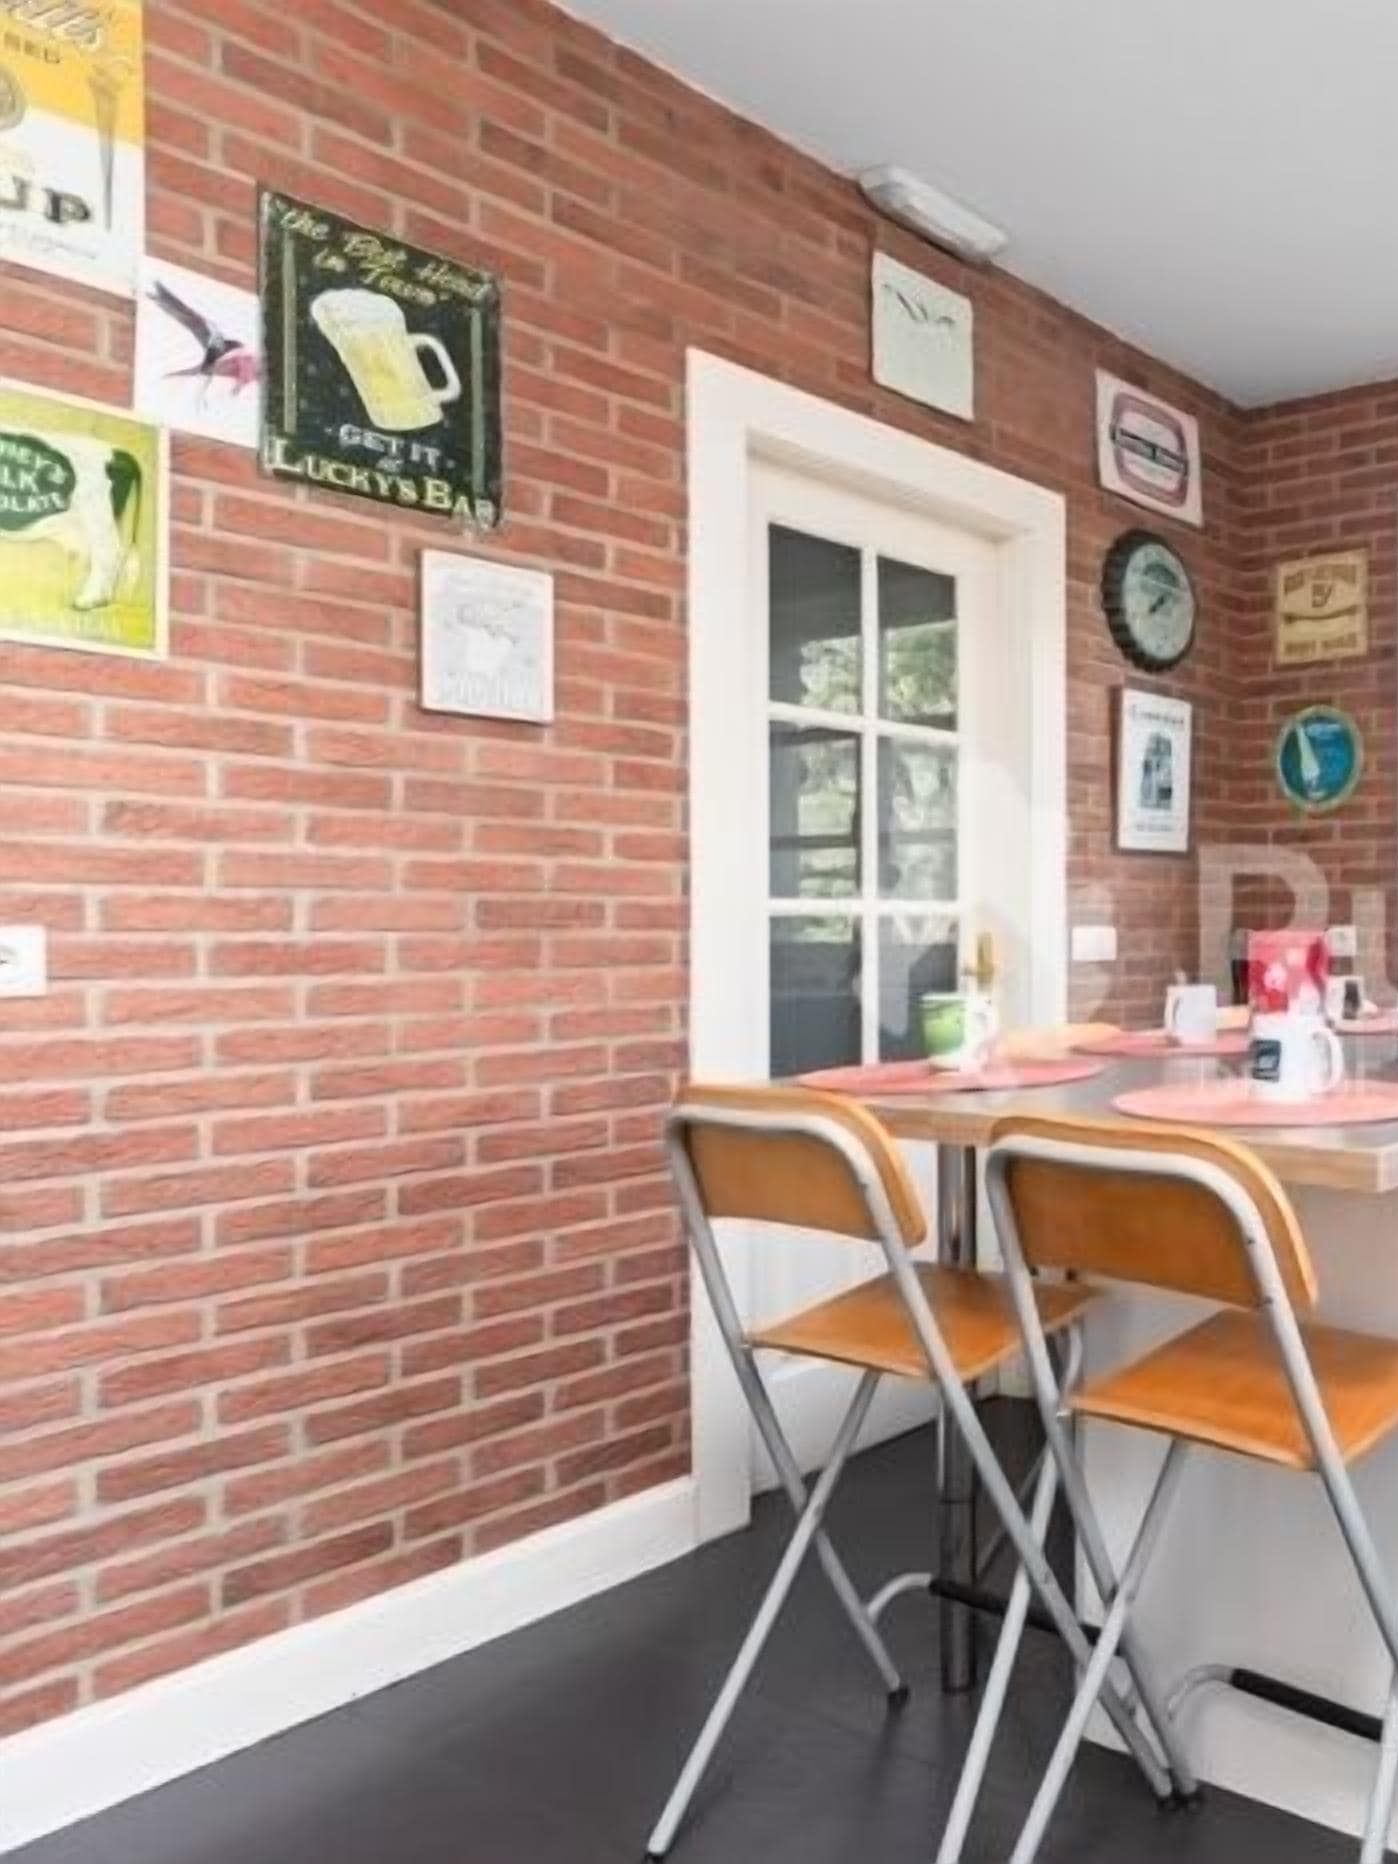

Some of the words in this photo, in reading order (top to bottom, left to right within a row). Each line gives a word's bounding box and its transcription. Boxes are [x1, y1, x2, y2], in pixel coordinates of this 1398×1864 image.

[338, 422, 404, 455] GET
[410, 442, 441, 473] IT
[424, 476, 496, 533] BAR
